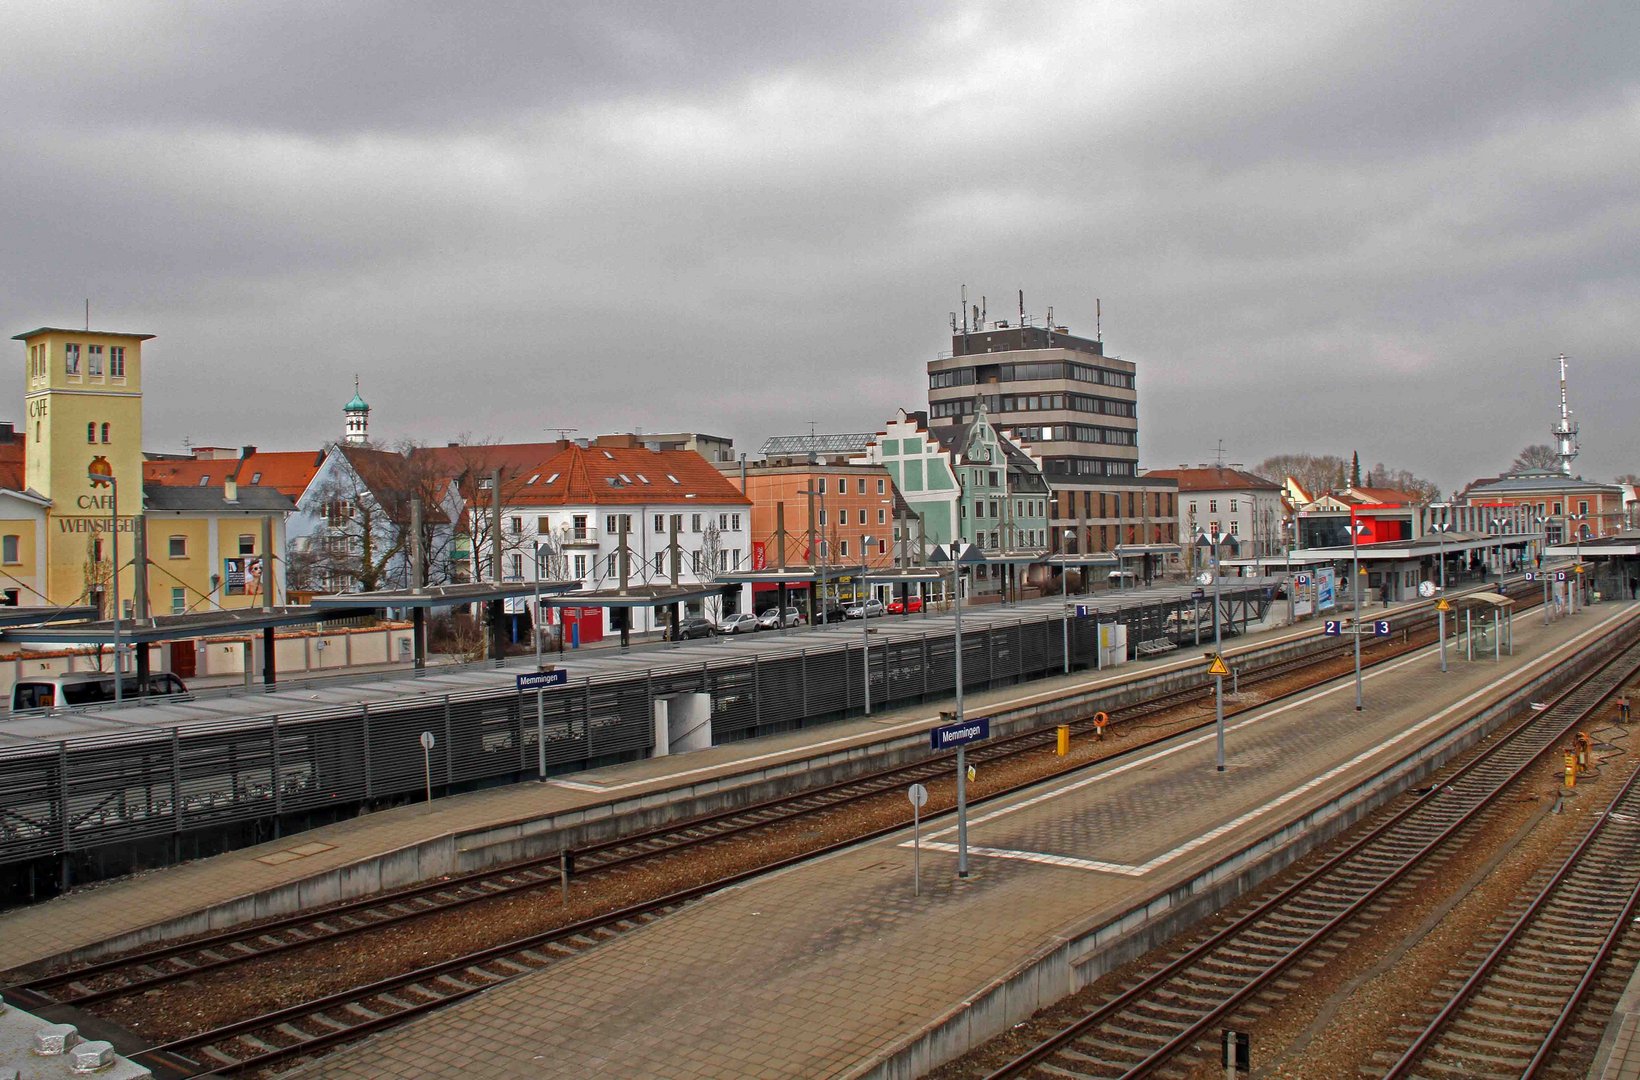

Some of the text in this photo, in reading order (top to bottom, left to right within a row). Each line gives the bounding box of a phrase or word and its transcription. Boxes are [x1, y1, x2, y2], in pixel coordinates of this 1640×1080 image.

[1300, 575, 1306, 583] D
[1081, 606, 1087, 615] 1
[1326, 622, 1335, 633] 2
[1380, 622, 1389, 633] 3
[520, 673, 558, 686] Memmingen
[942, 725, 981, 743] Memmingen
